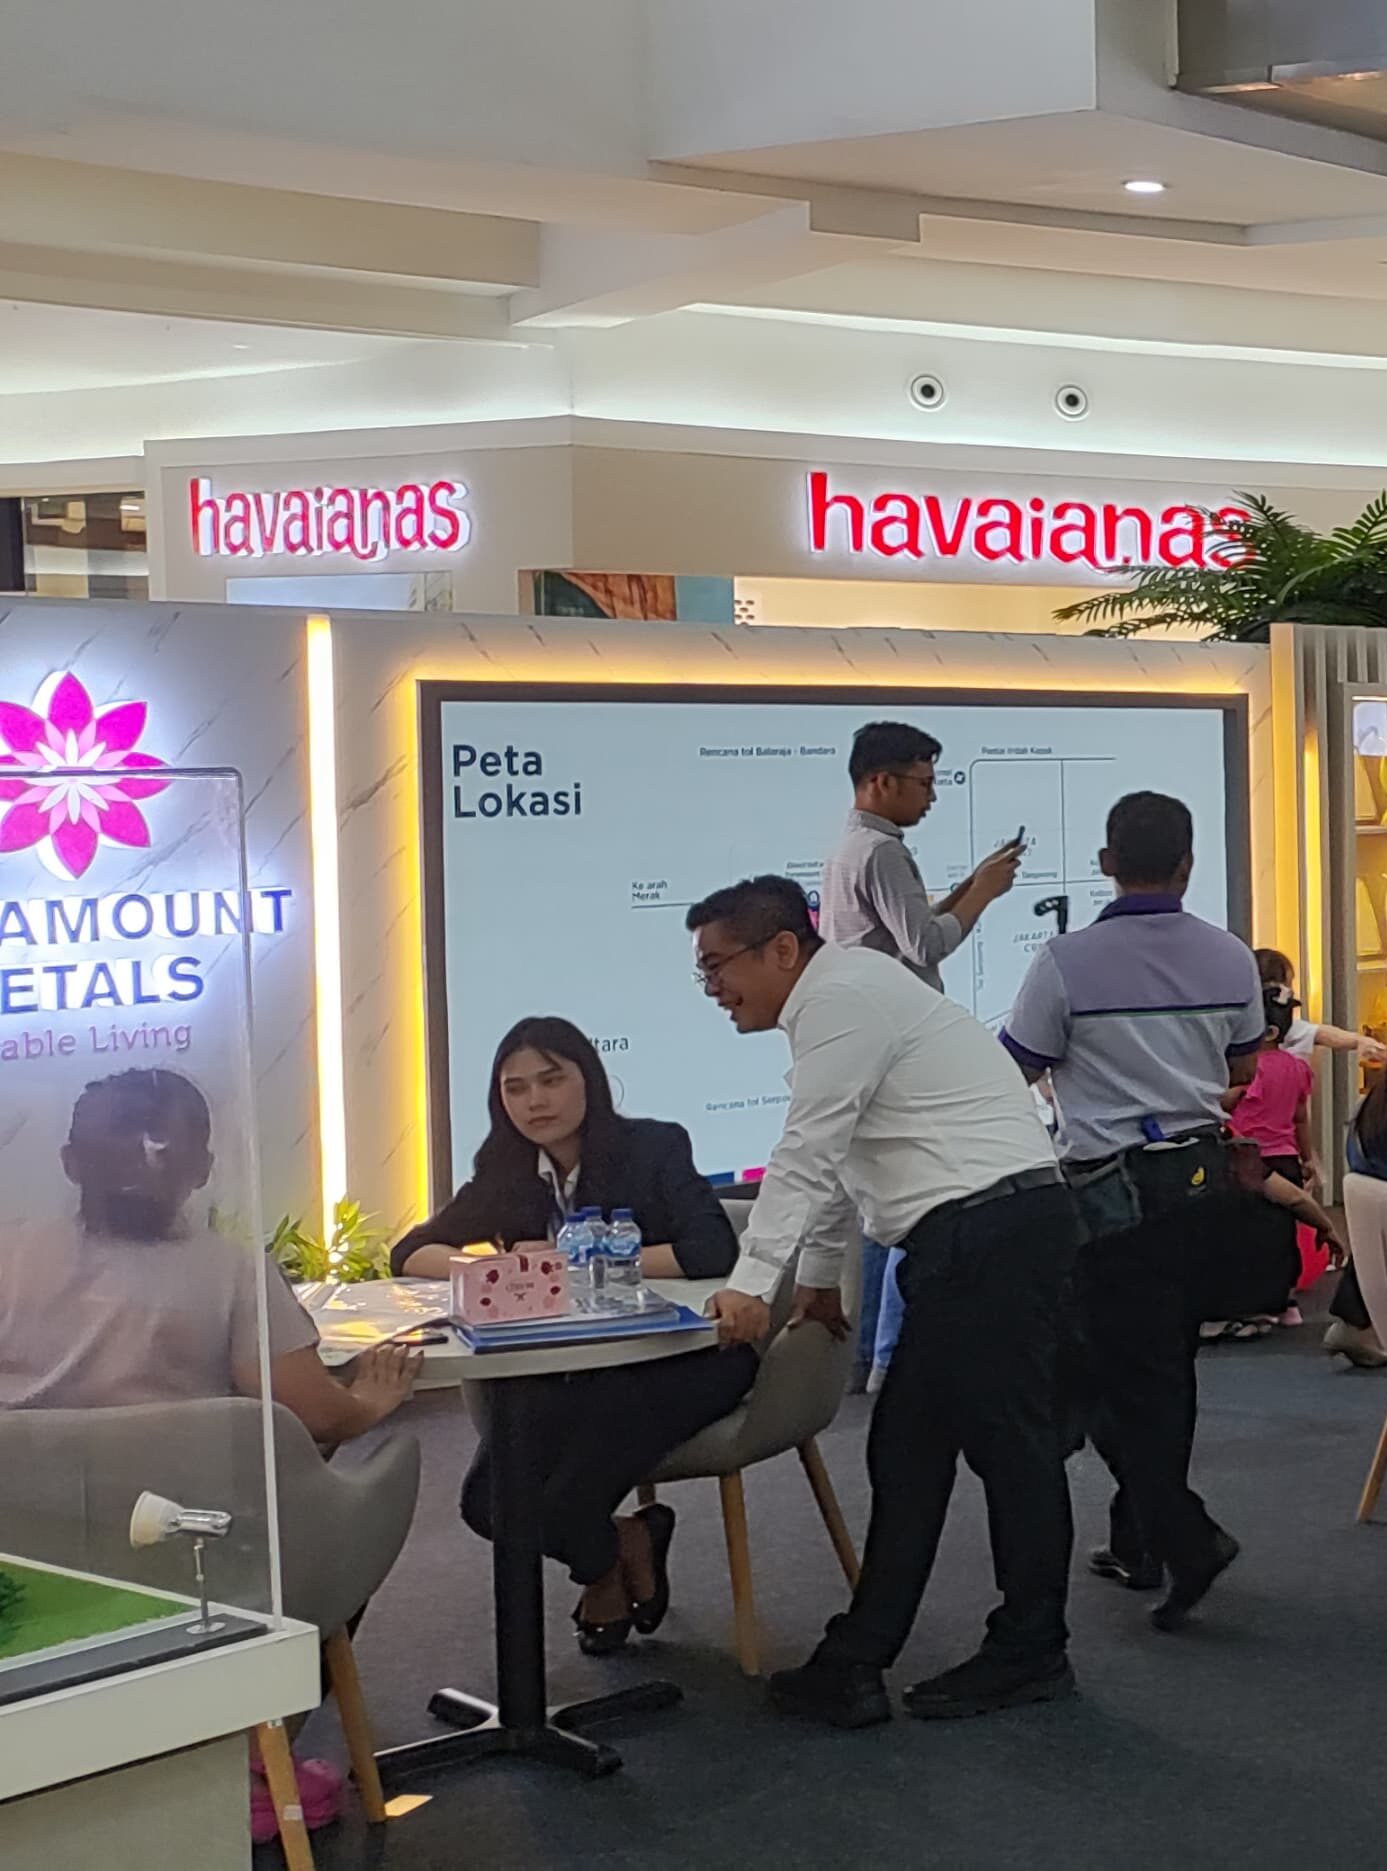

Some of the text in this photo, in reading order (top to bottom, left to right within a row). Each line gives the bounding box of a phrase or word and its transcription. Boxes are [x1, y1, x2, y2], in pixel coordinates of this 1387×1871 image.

[190, 477, 465, 561] havaianas
[453, 744, 543, 776] Peta
[453, 783, 582, 818] Lokasi
[89, 1022, 192, 1053] Living
[590, 1037, 629, 1052] tara
